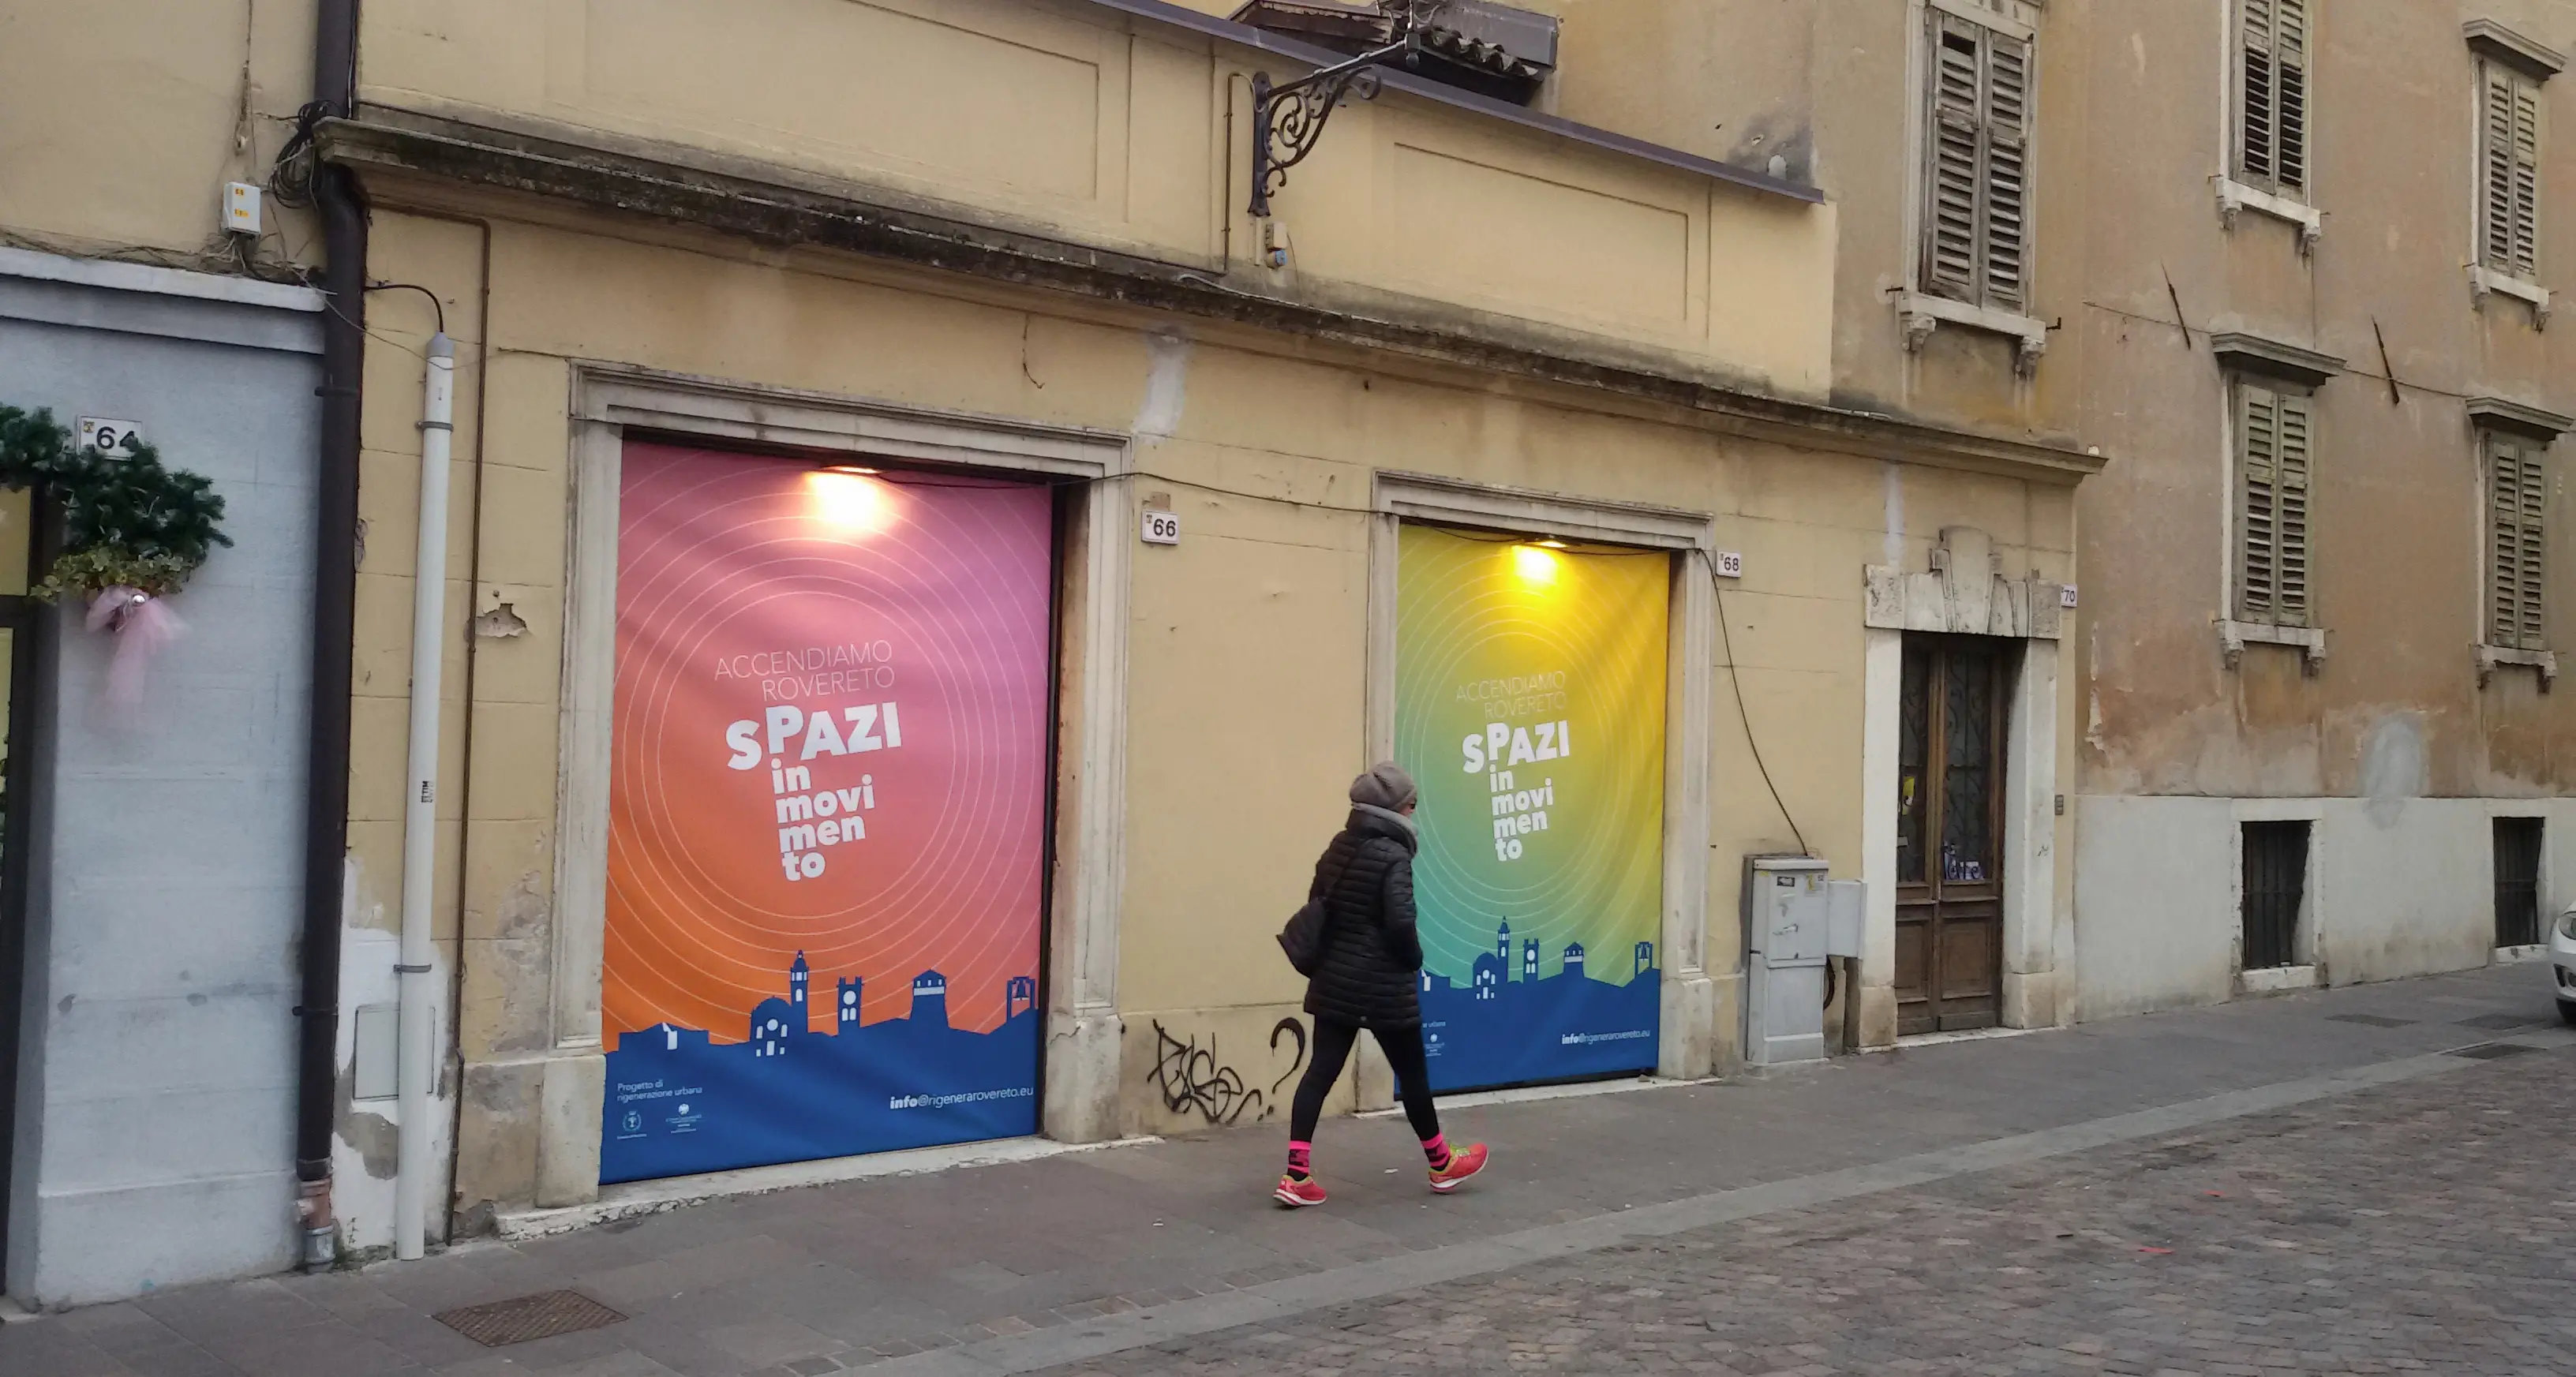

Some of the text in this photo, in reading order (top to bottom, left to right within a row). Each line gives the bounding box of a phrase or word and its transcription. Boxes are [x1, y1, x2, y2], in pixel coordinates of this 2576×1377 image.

[1153, 518, 1176, 537] 66
[1724, 556, 1739, 571] 68
[2064, 589, 2076, 602] 70
[714, 639, 893, 681] ACCENDIAMO
[762, 666, 895, 702] ROVERETO
[1455, 671, 1565, 702] ACCENDIAMO
[1485, 691, 1567, 720] ROVERETO
[770, 758, 811, 795] in
[1489, 764, 1514, 792] in
[776, 774, 874, 824] movi
[1492, 777, 1553, 816] movi
[778, 815, 866, 853] men
[1493, 810, 1548, 839] men
[1495, 837, 1522, 862] to
[781, 851, 826, 881] to
[616, 1086, 703, 1104] rigenerazione urbana
[617, 1079, 664, 1093] Progetto di
[889, 1086, 1034, 1109] info@rigenerarovereto.eu
